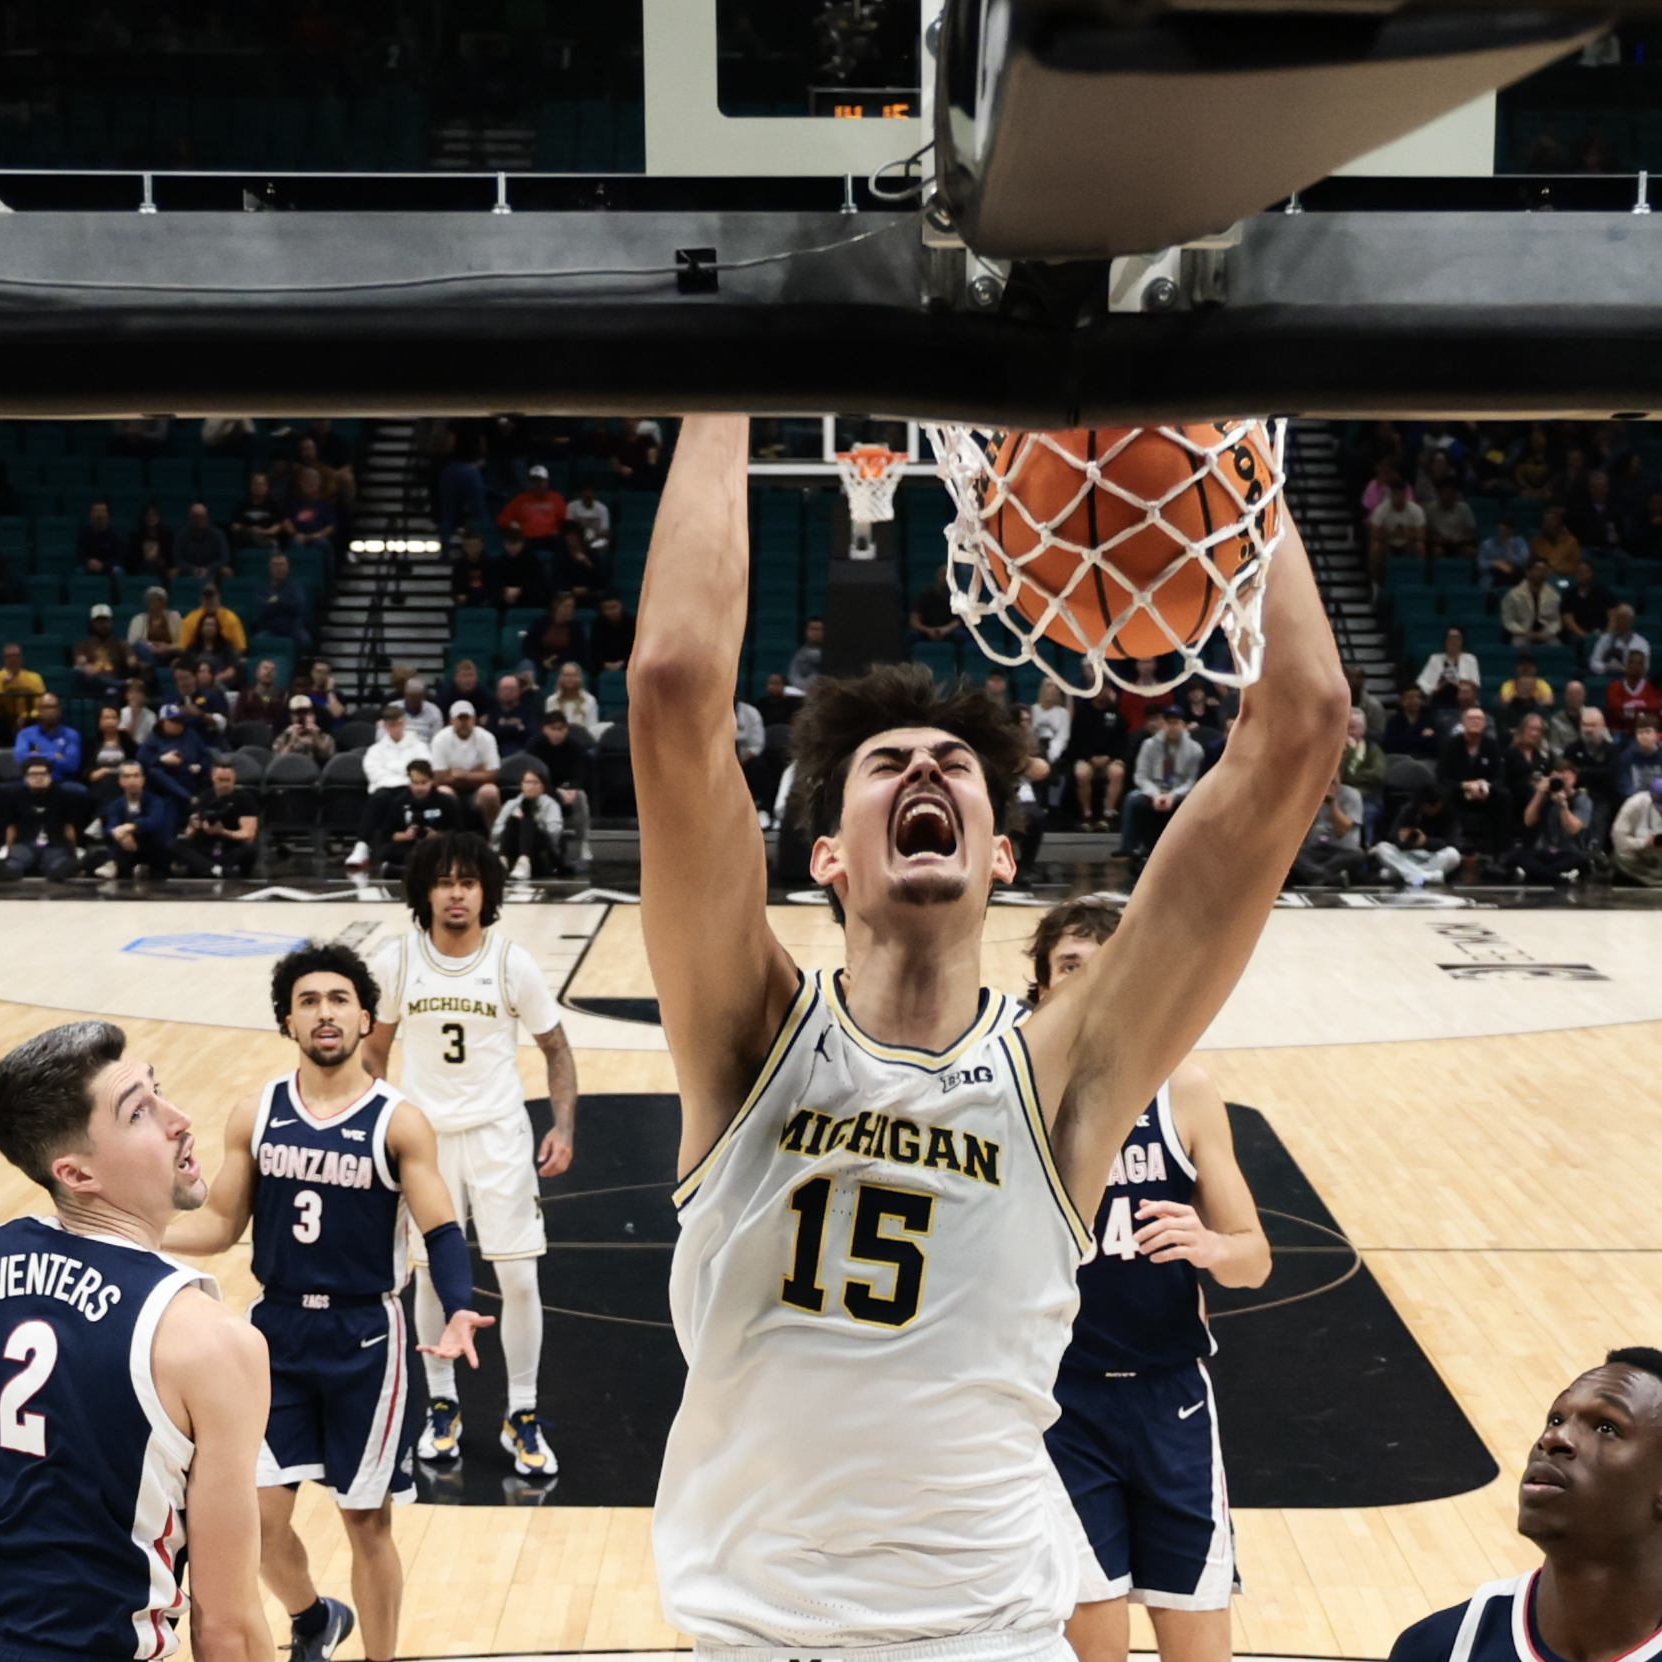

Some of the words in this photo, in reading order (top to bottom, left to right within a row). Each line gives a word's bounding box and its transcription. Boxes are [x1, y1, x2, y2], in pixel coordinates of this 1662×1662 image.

[407, 996, 498, 1019] MICHIGAN
[441, 1022, 467, 1064] 3
[258, 1142, 374, 1190] GONZAGA
[779, 1106, 1003, 1188] MICHIGAN
[291, 1189, 324, 1246] 3
[779, 1175, 938, 1330] 15
[301, 1293, 331, 1310] ZAGS
